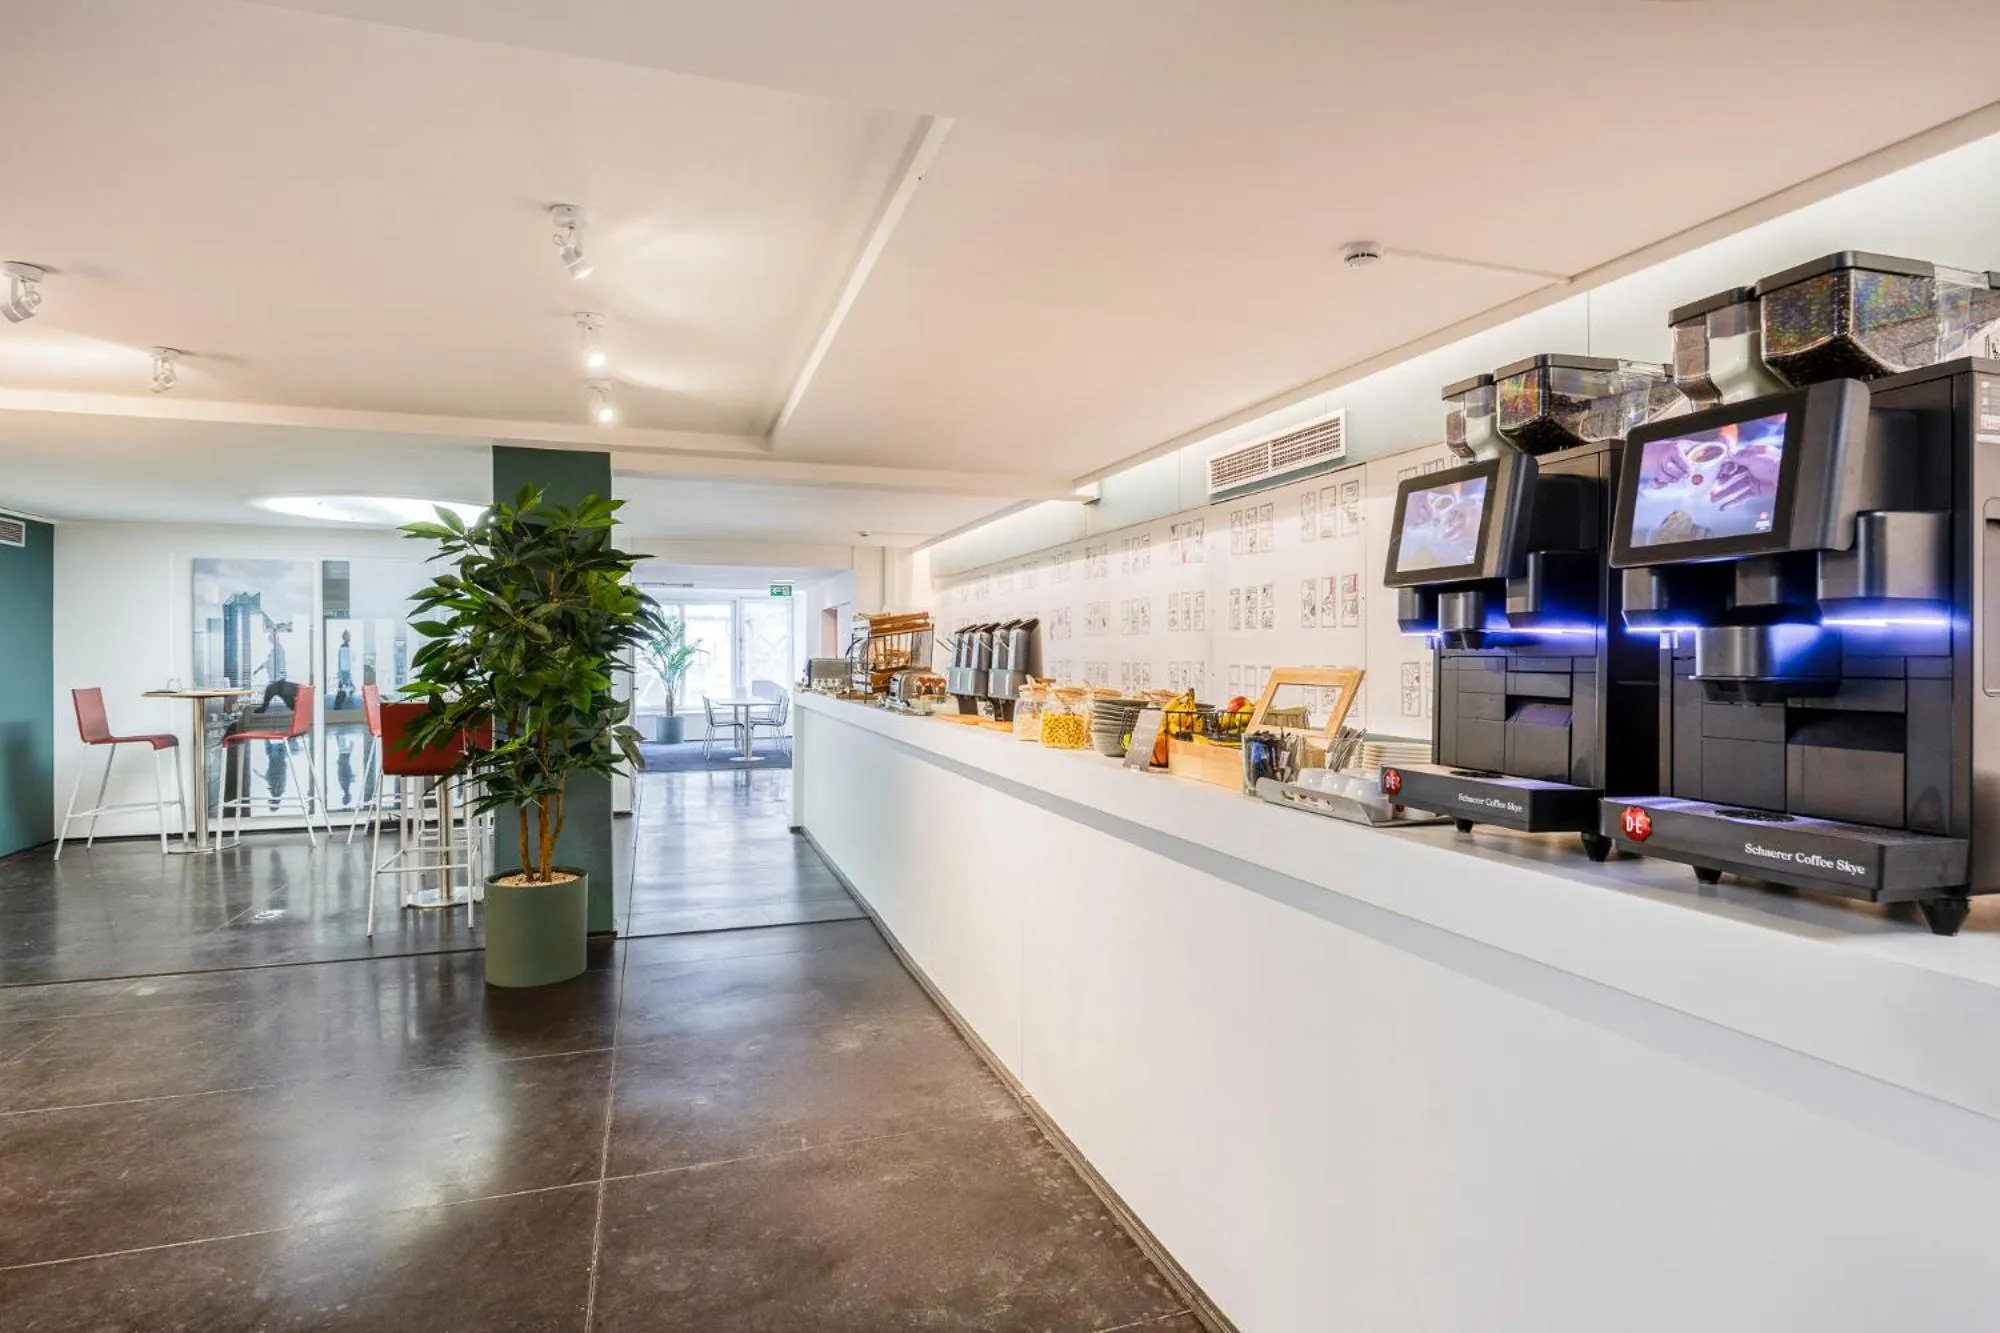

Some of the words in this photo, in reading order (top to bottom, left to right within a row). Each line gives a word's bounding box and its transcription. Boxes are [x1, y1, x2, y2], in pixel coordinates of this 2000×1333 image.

[1744, 843, 1793, 861] Schaerer
[1795, 852, 1834, 869] Coffee
[1836, 859, 1866, 876] Skye
